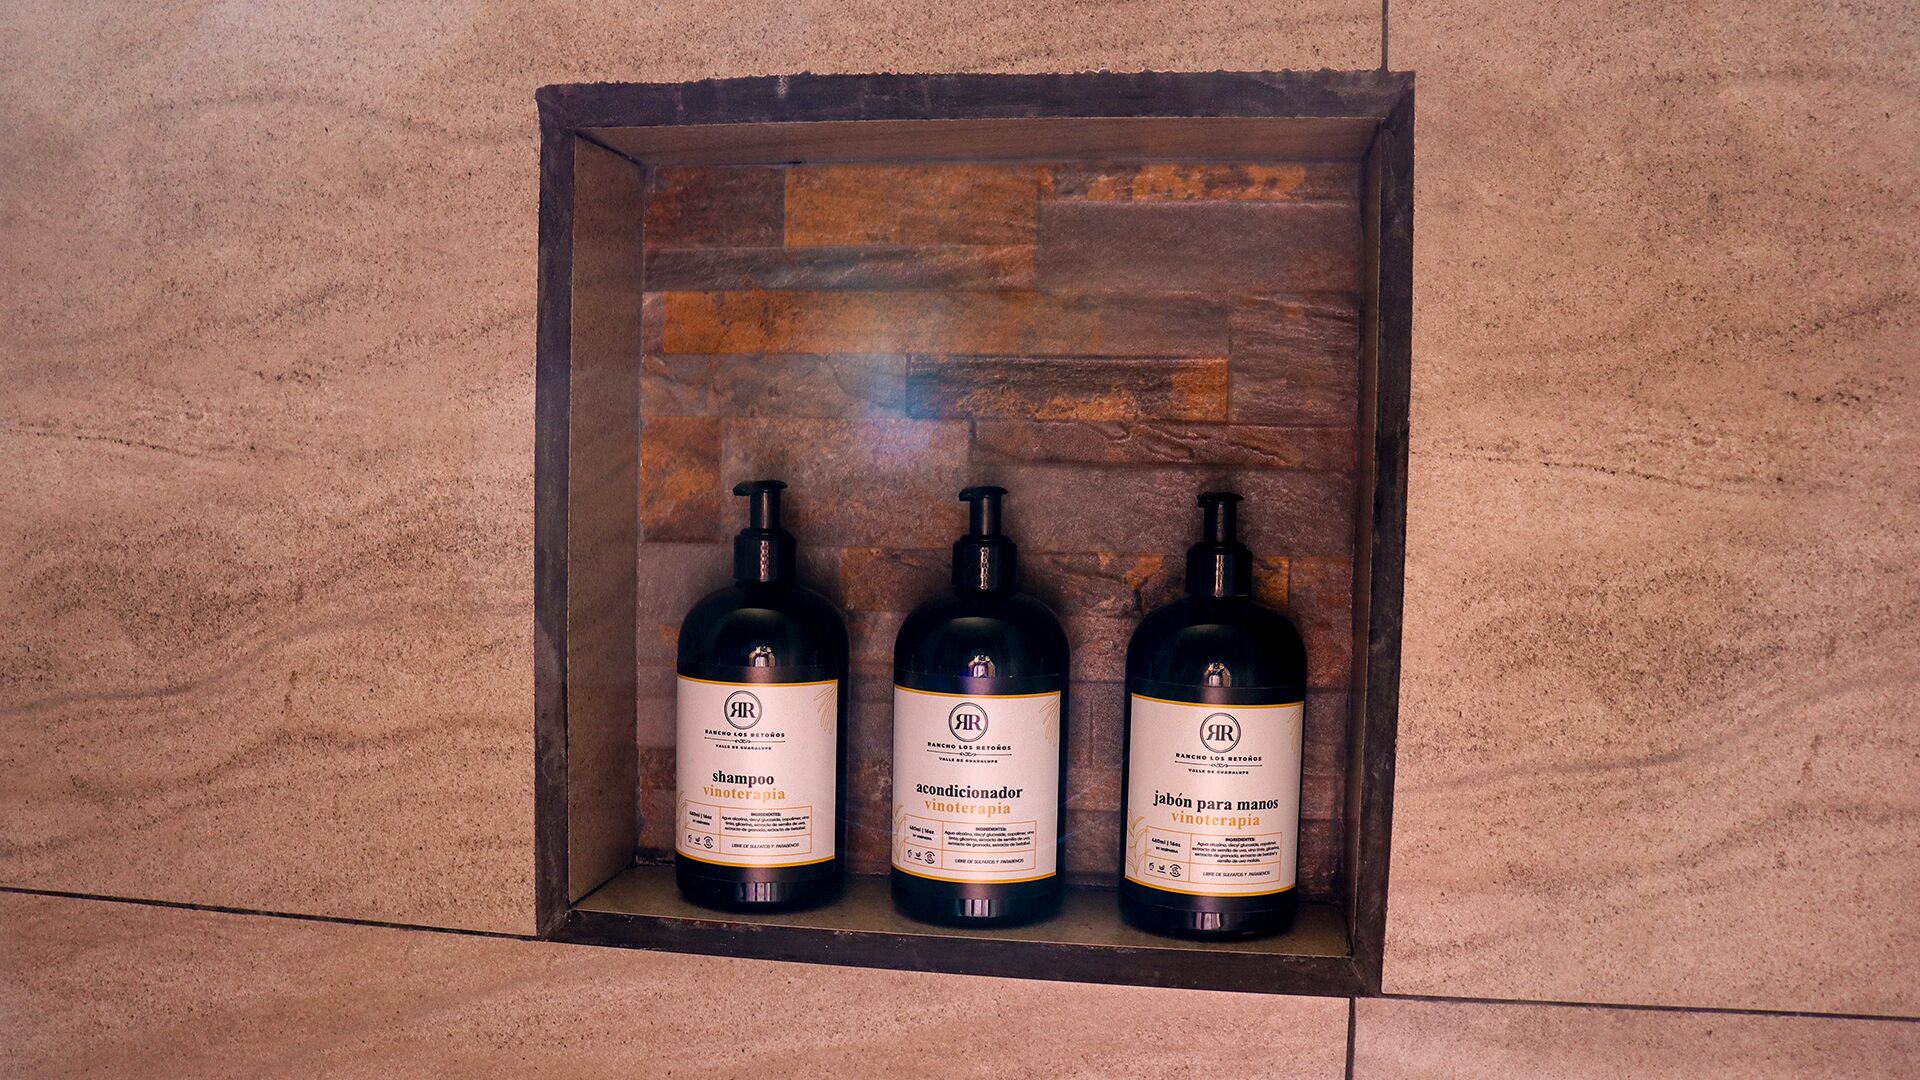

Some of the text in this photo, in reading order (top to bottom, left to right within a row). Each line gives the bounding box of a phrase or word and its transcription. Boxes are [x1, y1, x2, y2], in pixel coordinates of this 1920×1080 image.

[713, 771, 774, 788] shampoo
[704, 785, 785, 802] vinoterapia
[917, 783, 1023, 798] acondicionador
[924, 799, 1011, 818] vinoterapia
[1153, 790, 1278, 812] jabón para manos
[1171, 811, 1260, 829] vinoterapia
